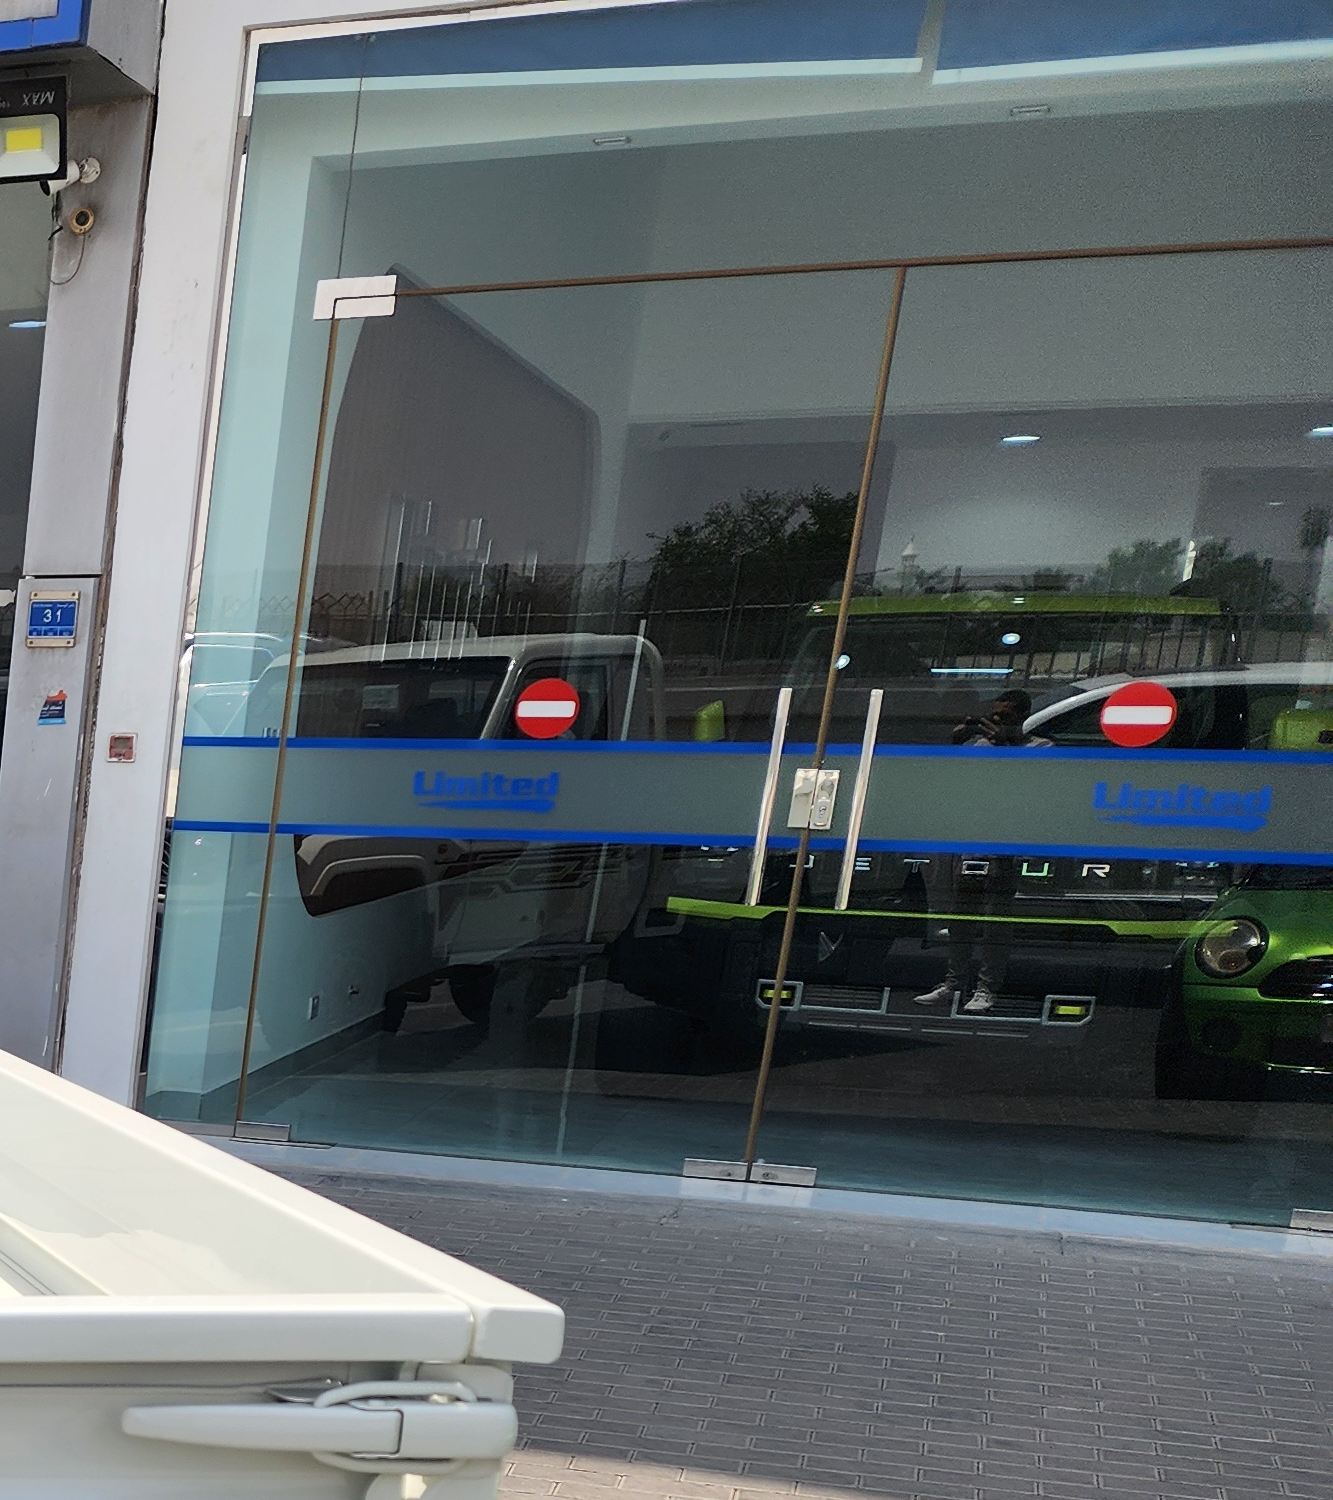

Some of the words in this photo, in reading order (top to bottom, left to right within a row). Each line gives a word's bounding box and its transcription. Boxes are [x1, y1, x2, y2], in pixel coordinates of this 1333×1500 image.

[43, 608, 62, 623] 31
[413, 770, 560, 798] Limited
[1093, 781, 1274, 814] Limited
